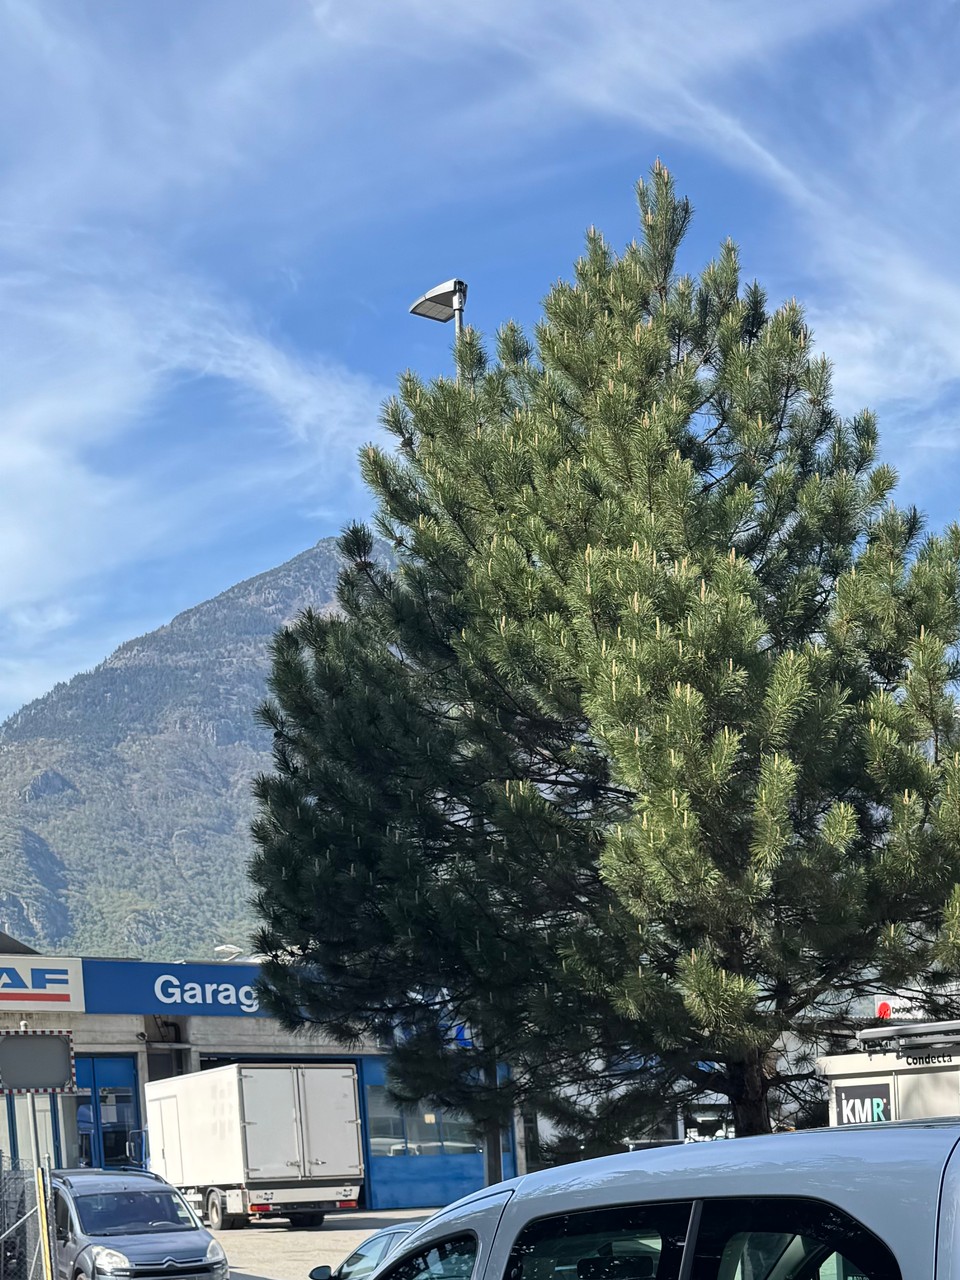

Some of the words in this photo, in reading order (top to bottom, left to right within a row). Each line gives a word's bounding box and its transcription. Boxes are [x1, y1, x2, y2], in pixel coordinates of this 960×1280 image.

[0, 967, 69, 989] AF
[154, 974, 261, 1012] Garag
[906, 1053, 952, 1066] Condecta
